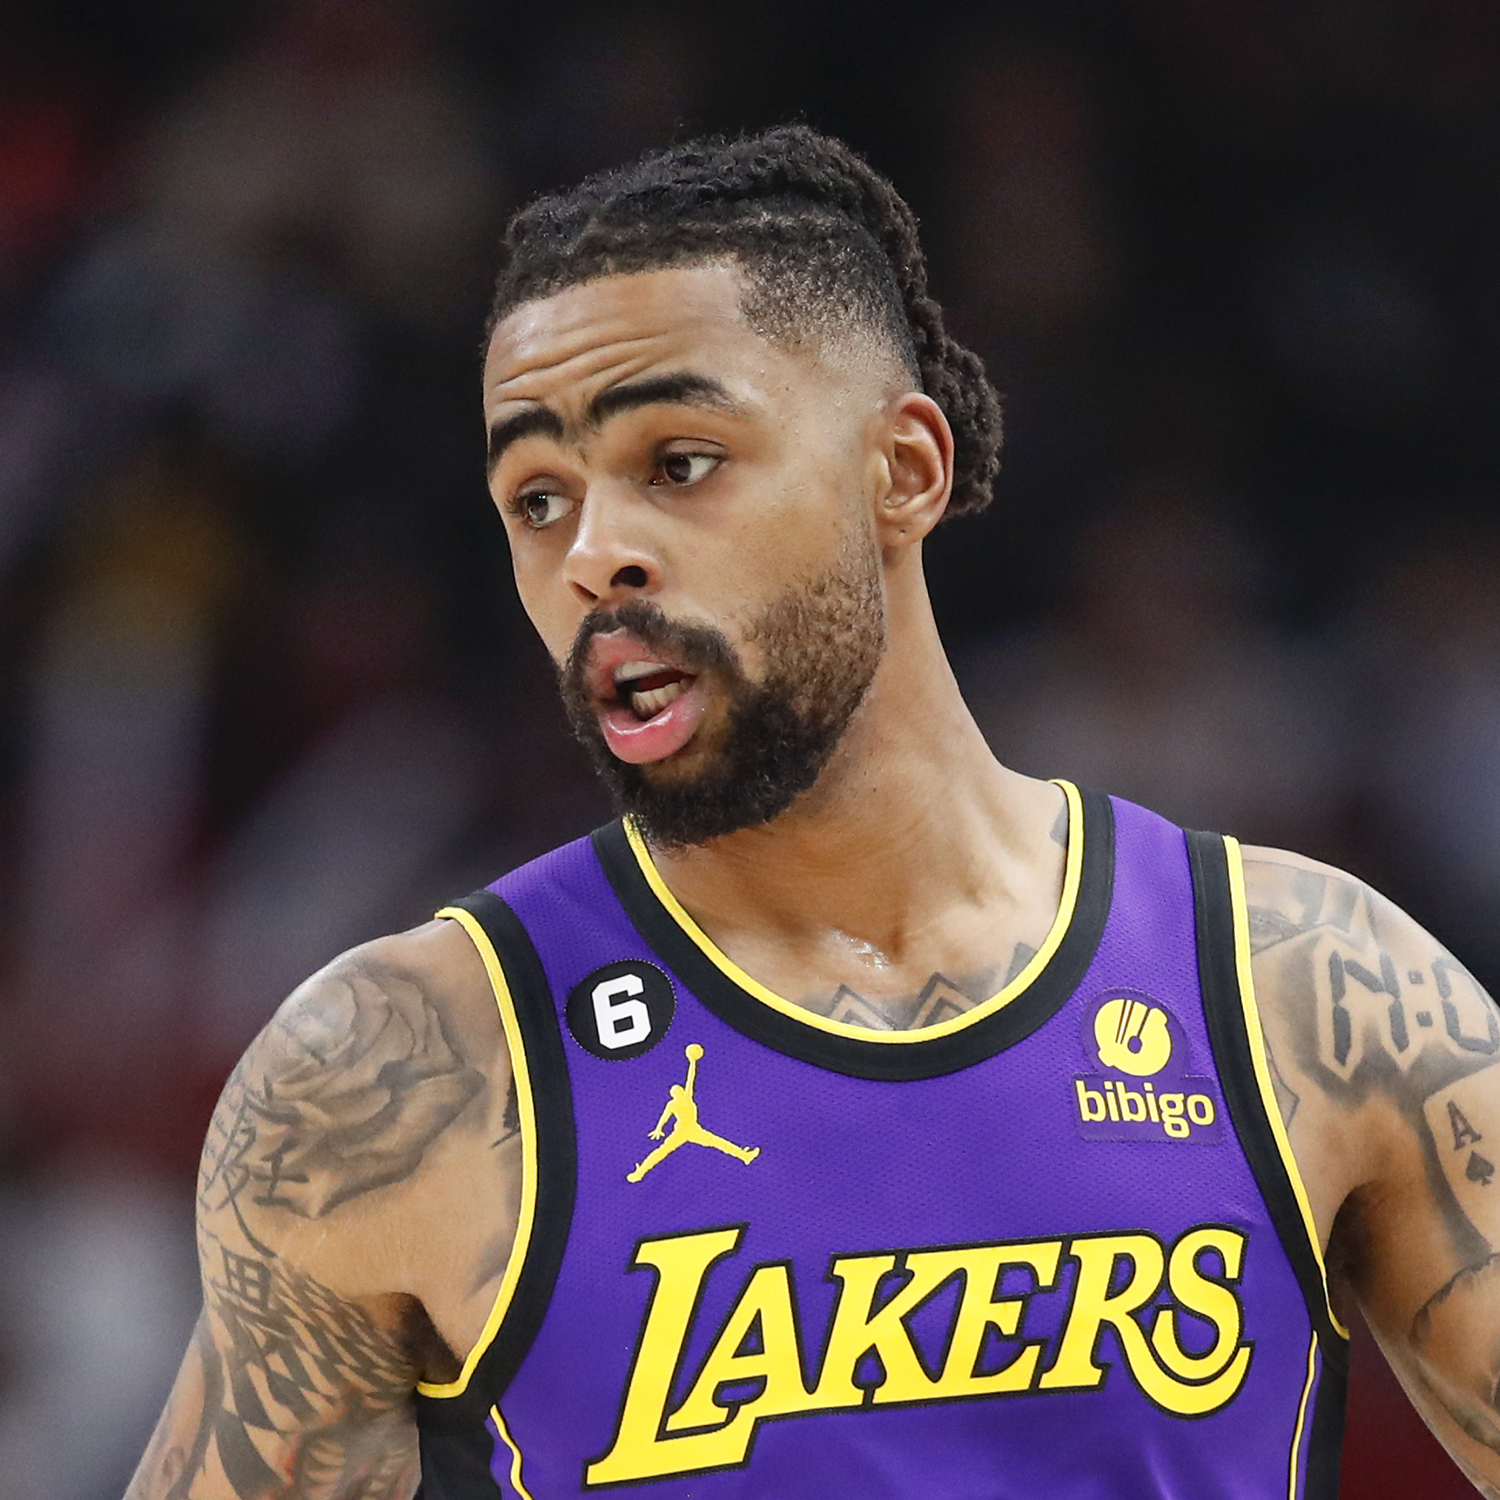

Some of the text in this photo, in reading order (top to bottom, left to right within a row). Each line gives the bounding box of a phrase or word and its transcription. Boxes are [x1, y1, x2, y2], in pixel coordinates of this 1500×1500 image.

[591, 973, 652, 1050] 6
[1078, 1079, 1215, 1139] bibigo
[1447, 1100, 1483, 1152] A
[581, 1221, 1255, 1492] LAKERS
